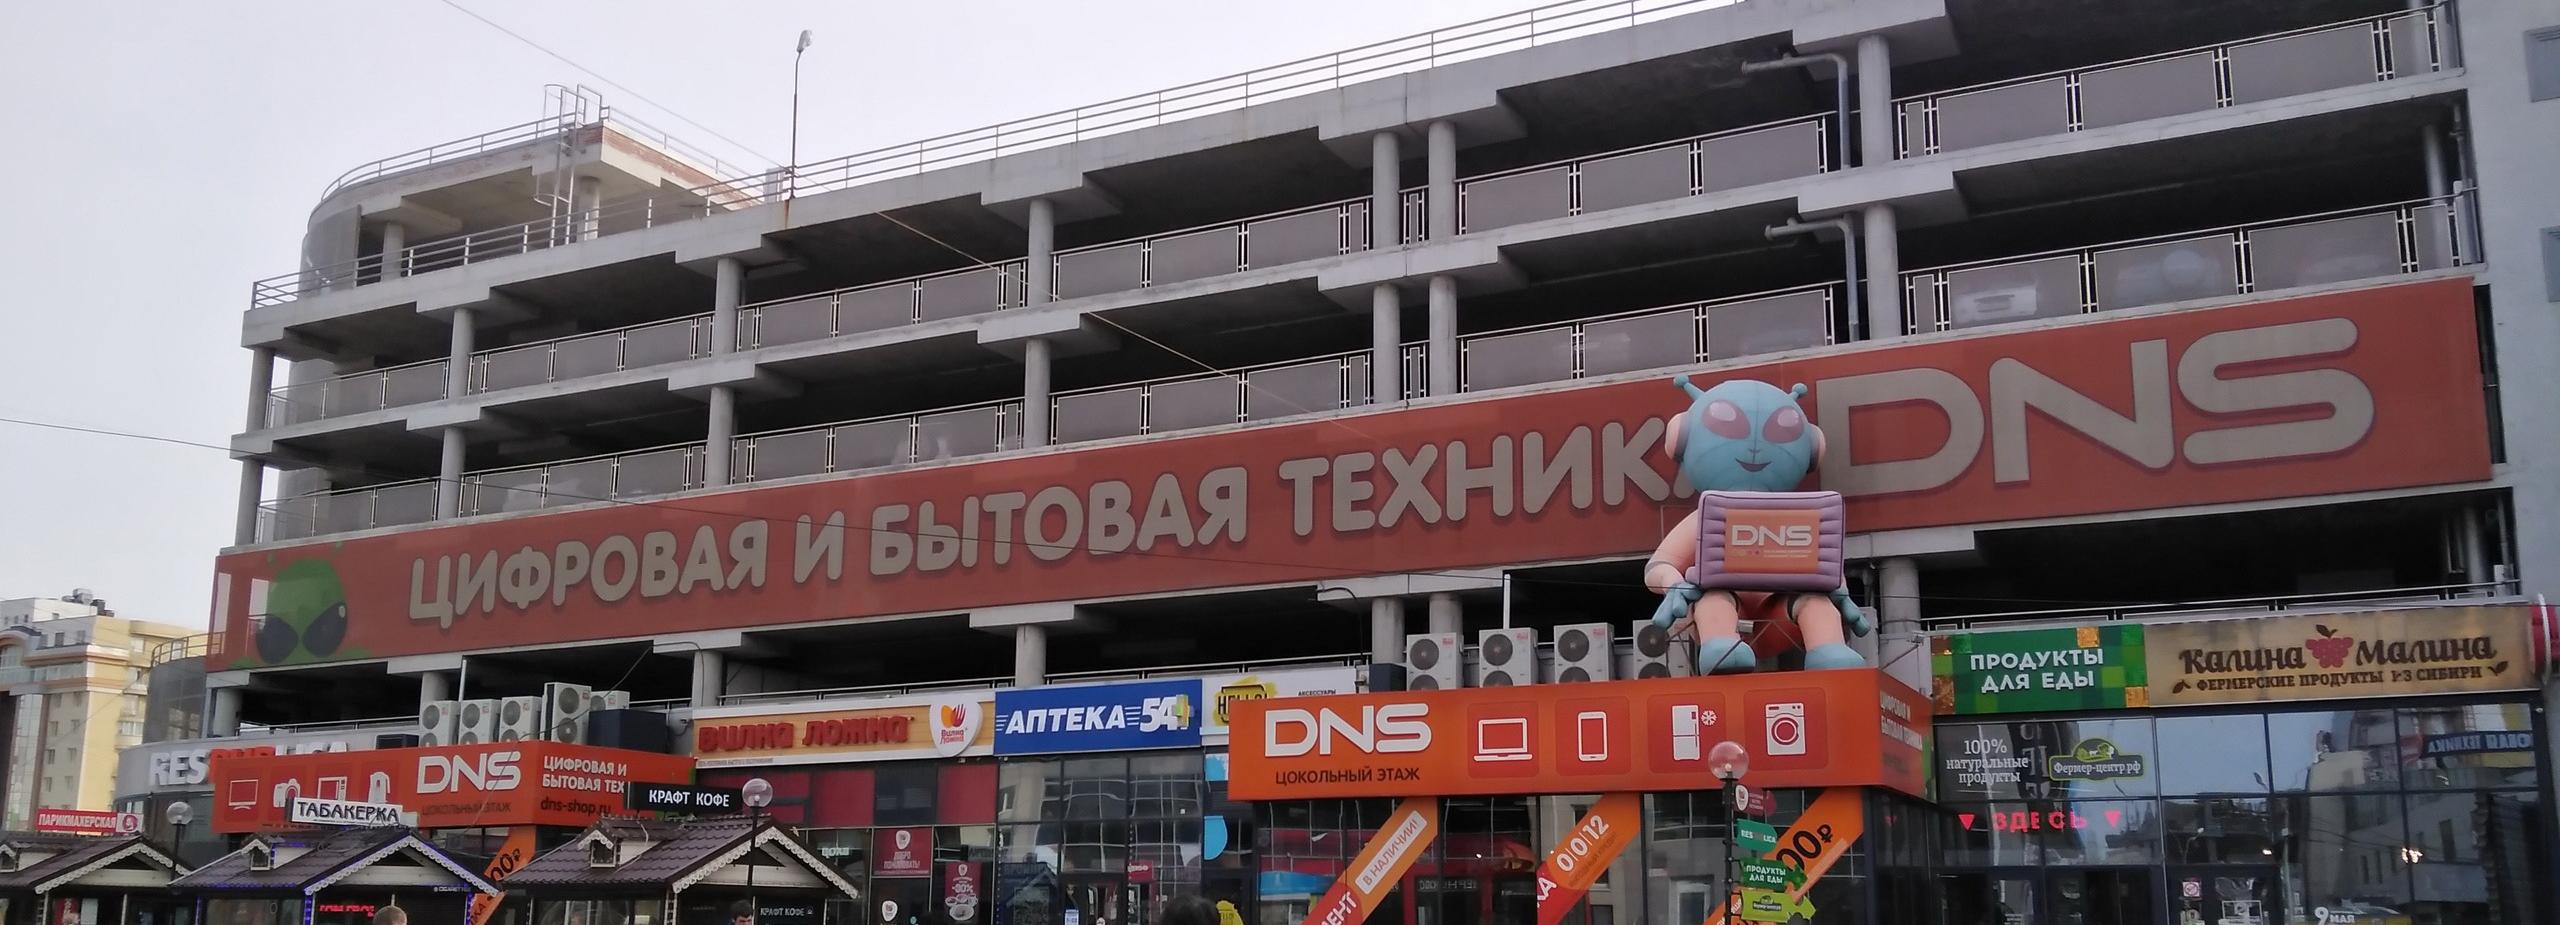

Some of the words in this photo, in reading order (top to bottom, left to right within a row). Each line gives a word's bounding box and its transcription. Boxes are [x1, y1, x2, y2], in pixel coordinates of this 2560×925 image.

[1816, 317, 2375, 496] DNS
[408, 519, 769, 630] ЦИФРОВАЯ
[793, 510, 846, 584] И
[869, 466, 1249, 576] БЫТОВАЯ
[1278, 416, 1697, 537] ТЕХНИК
[1731, 524, 1813, 547] DNS
[1970, 648, 2103, 671] ПРОДУКТЫ
[2179, 646, 2307, 674] Калина
[2355, 636, 2497, 666] Малина
[1981, 673, 2030, 693] ДЛЯ
[2041, 671, 2094, 691] ЕДЫ
[2197, 674, 2296, 691] ФЕРМЕРСКИЕ
[2299, 670, 2384, 687] ПРОДУКТЫ
[2416, 666, 2483, 681] СИБИРИ
[1005, 704, 1126, 734] АПТЕКА
[1264, 703, 1433, 757] DNS
[1963, 738, 2008, 755] 100%
[416, 751, 521, 794] DNS
[543, 756, 615, 775] ЦИФРОВАЯ
[617, 762, 628, 777] И
[1275, 766, 1372, 786] ЦОКОЛЬНЫЙ
[1376, 767, 1421, 783] ЭТАЖ
[1946, 757, 2029, 774] натуральные
[542, 775, 601, 793] БЫТОВАЯ
[1958, 771, 2021, 787] продукты
[540, 797, 612, 818] dns-shop.ru
[649, 789, 691, 806] КРАФТ
[695, 793, 730, 808] КОФЕ
[38, 813, 117, 829] ПАРИКМАХЕРСКАЯ
[297, 802, 401, 823] ТАБАКЕРКА
[1371, 819, 1419, 878] НАЛИЧИИ!
[1746, 864, 1787, 876] ПРОДУКТЫ
[1749, 874, 1765, 882] ДЛЯ
[1766, 875, 1783, 884] ЕДЫ
